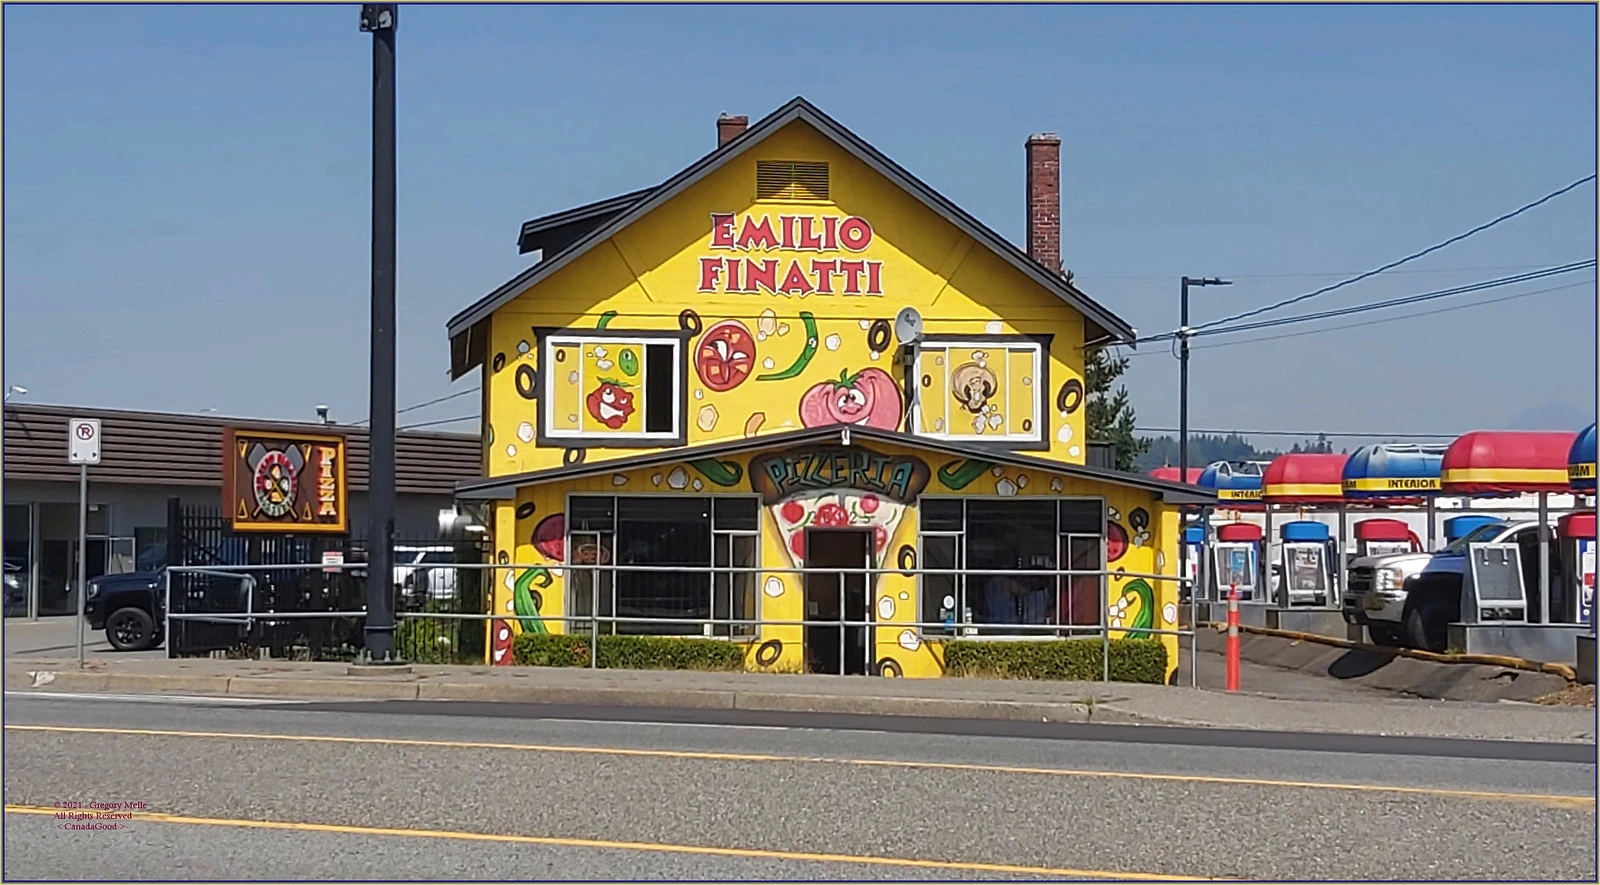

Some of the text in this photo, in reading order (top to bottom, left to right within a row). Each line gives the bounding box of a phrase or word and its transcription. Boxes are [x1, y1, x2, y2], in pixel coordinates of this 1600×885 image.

[710, 212, 873, 253] EMILIO
[697, 256, 884, 299] FINATTI
[318, 446, 337, 516] PIZZA
[762, 452, 914, 500] PIZZERIA
[1388, 479, 1436, 489] INTERIOR
